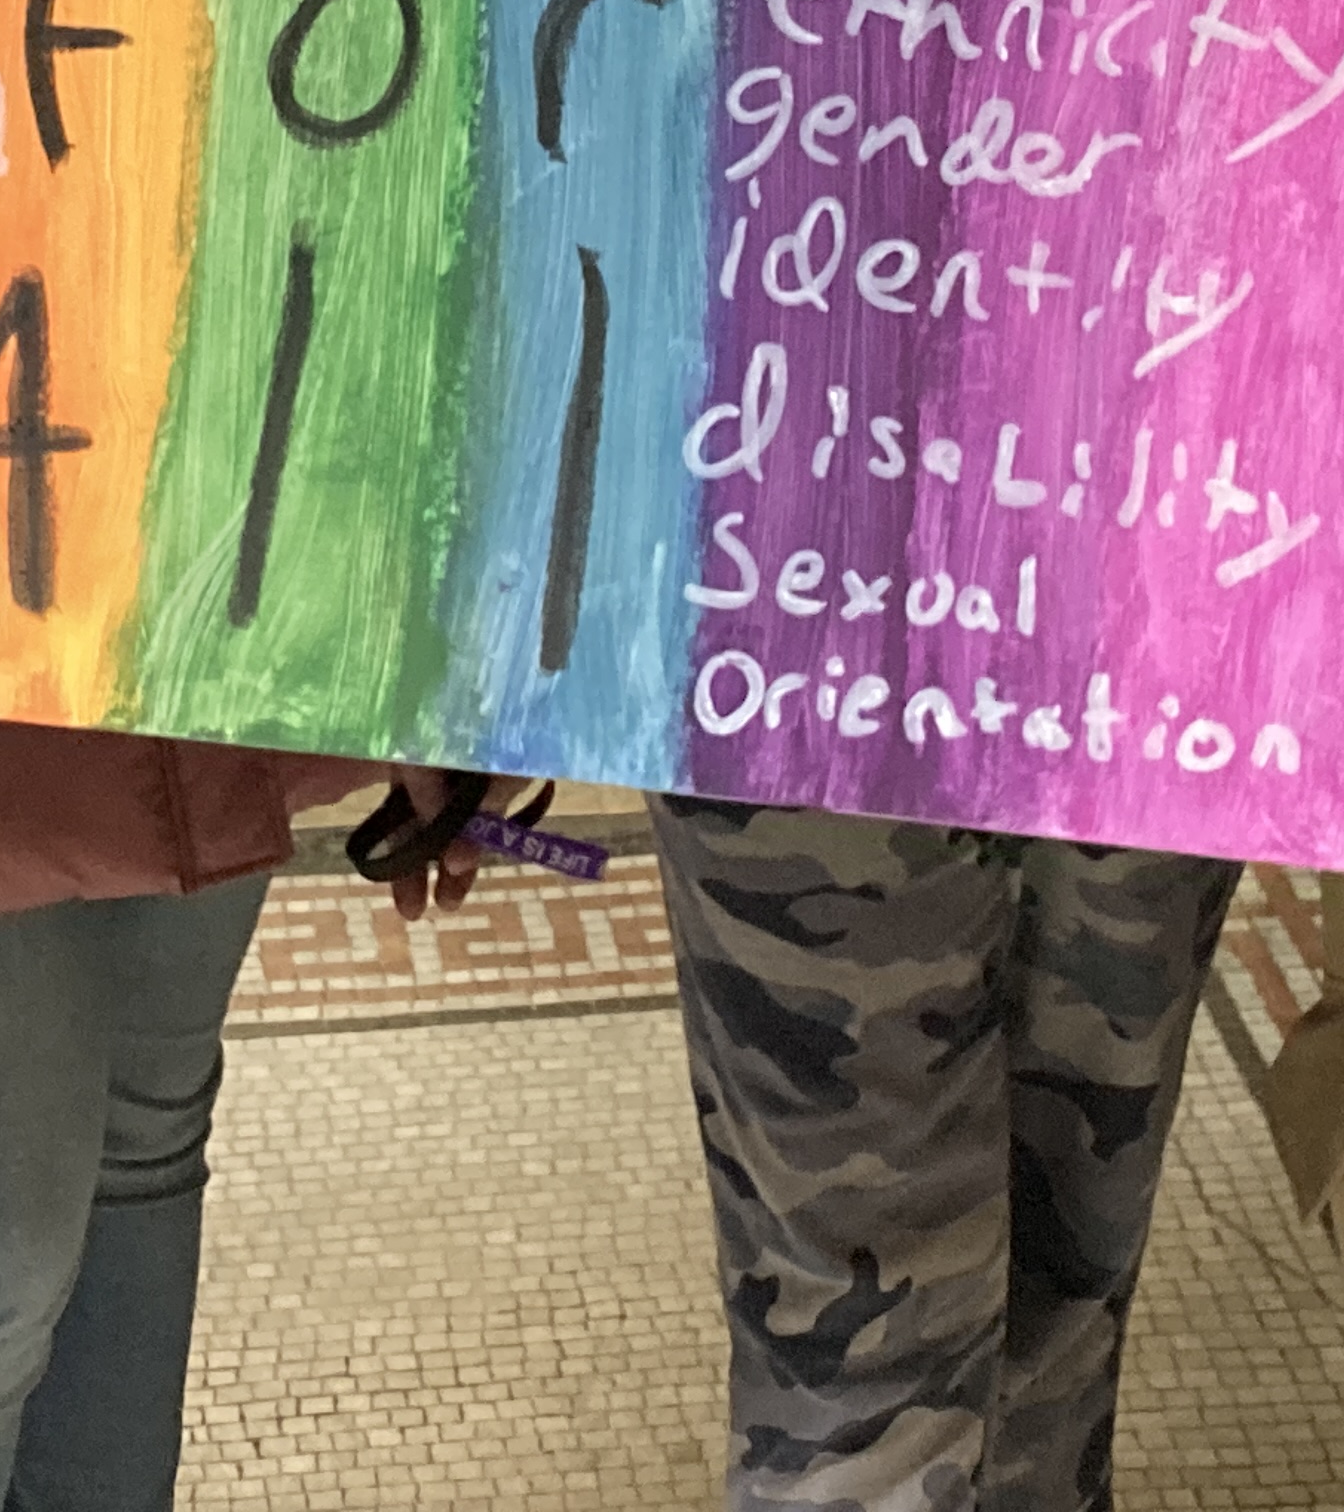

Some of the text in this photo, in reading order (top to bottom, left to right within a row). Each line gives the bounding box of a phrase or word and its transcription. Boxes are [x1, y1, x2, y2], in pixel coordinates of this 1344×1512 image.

[722, 65, 1143, 198] gender
[718, 178, 1255, 380] identity
[683, 510, 1038, 635] Sexual
[692, 649, 1302, 776] Orientation
[498, 826, 518, 848] A
[520, 835, 546, 863] IS
[548, 849, 594, 876] LIFE
